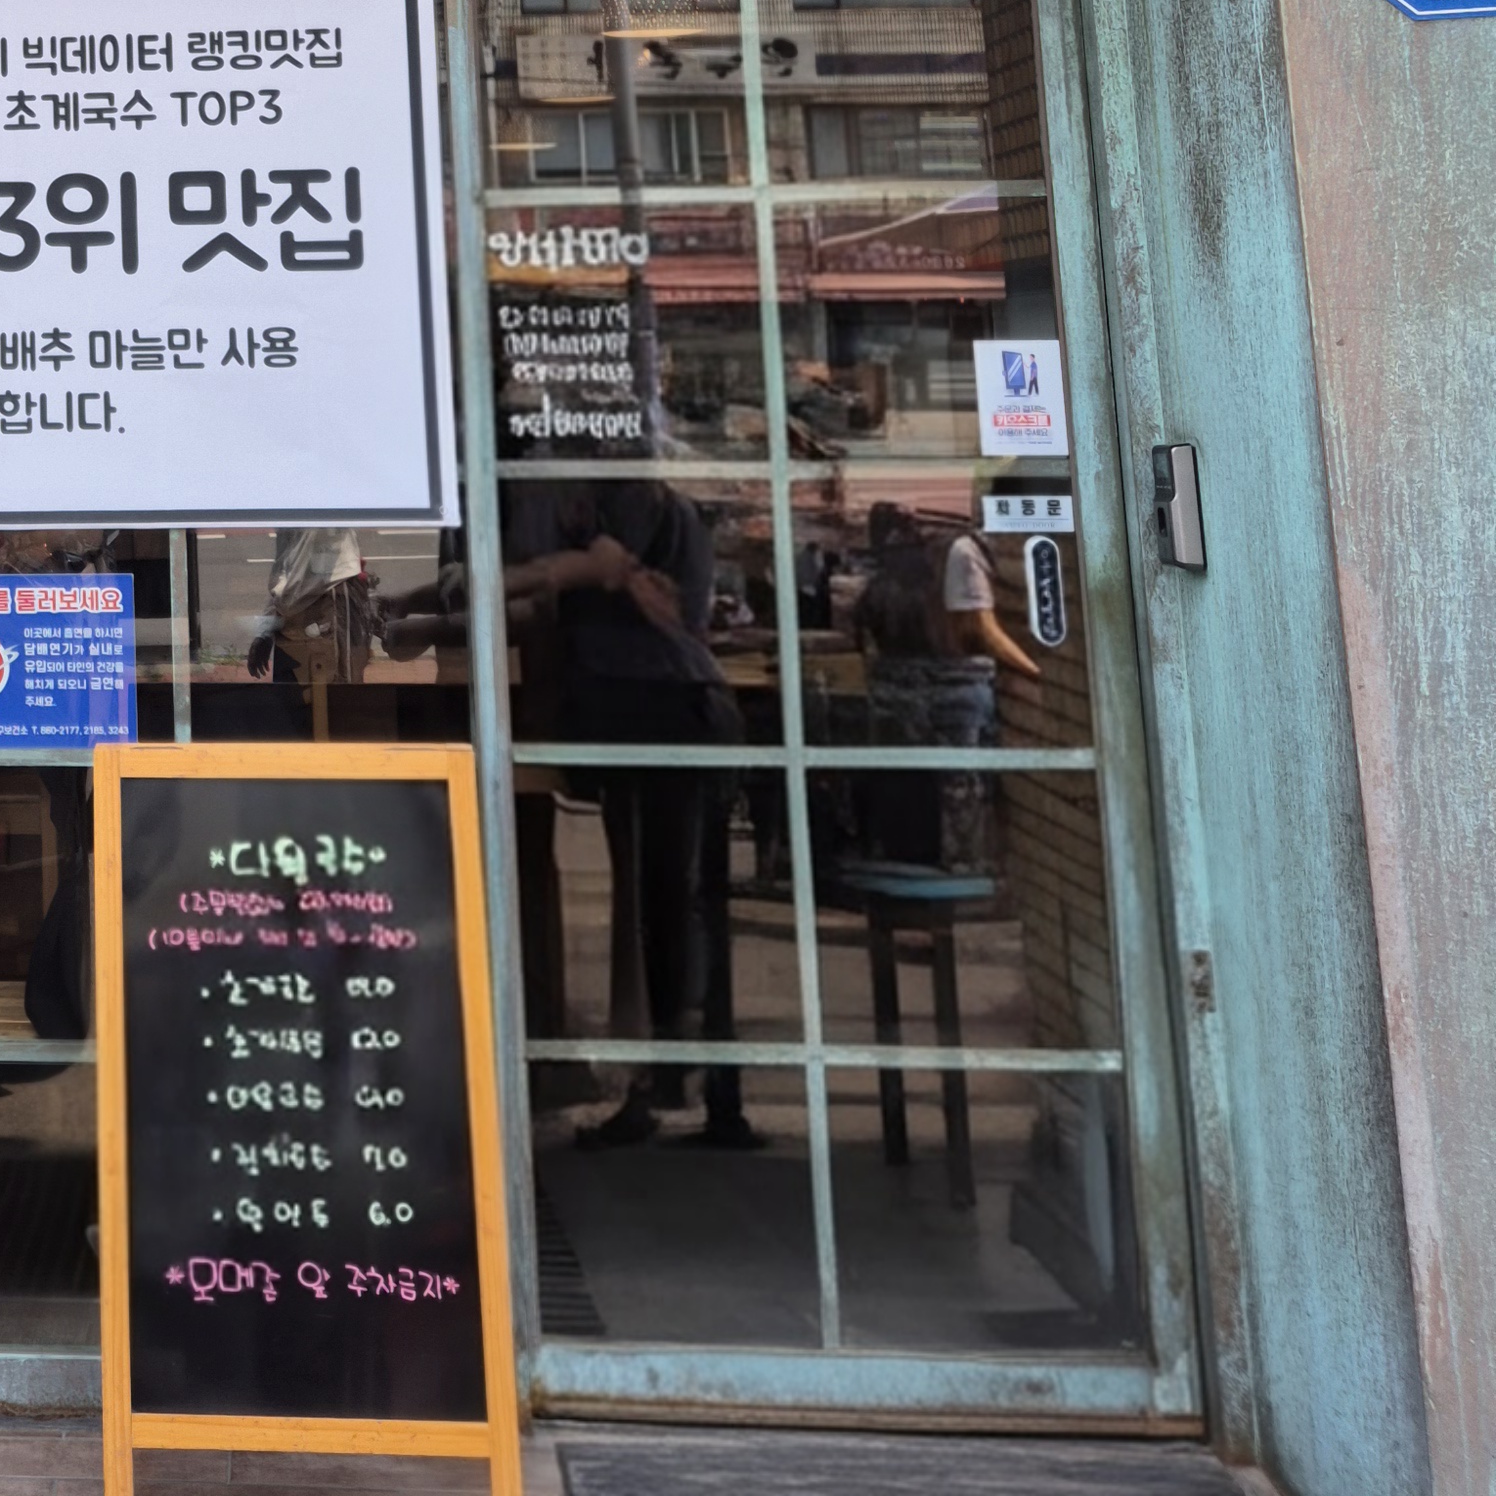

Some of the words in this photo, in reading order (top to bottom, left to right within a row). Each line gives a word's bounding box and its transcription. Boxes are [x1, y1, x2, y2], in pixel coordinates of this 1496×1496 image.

[22, 33, 174, 77] 빅데이터
[187, 28, 343, 71] 랭킹맛집
[4, 89, 157, 131] 초계국수
[169, 89, 283, 127] TOP3
[168, 167, 364, 272] 맛집
[0, 328, 75, 372] 배추
[88, 327, 208, 370] 마늘만
[220, 326, 299, 369] 사용
[15, 587, 123, 613] 둘러보세요
[24, 643, 84, 656] 담배연기가
